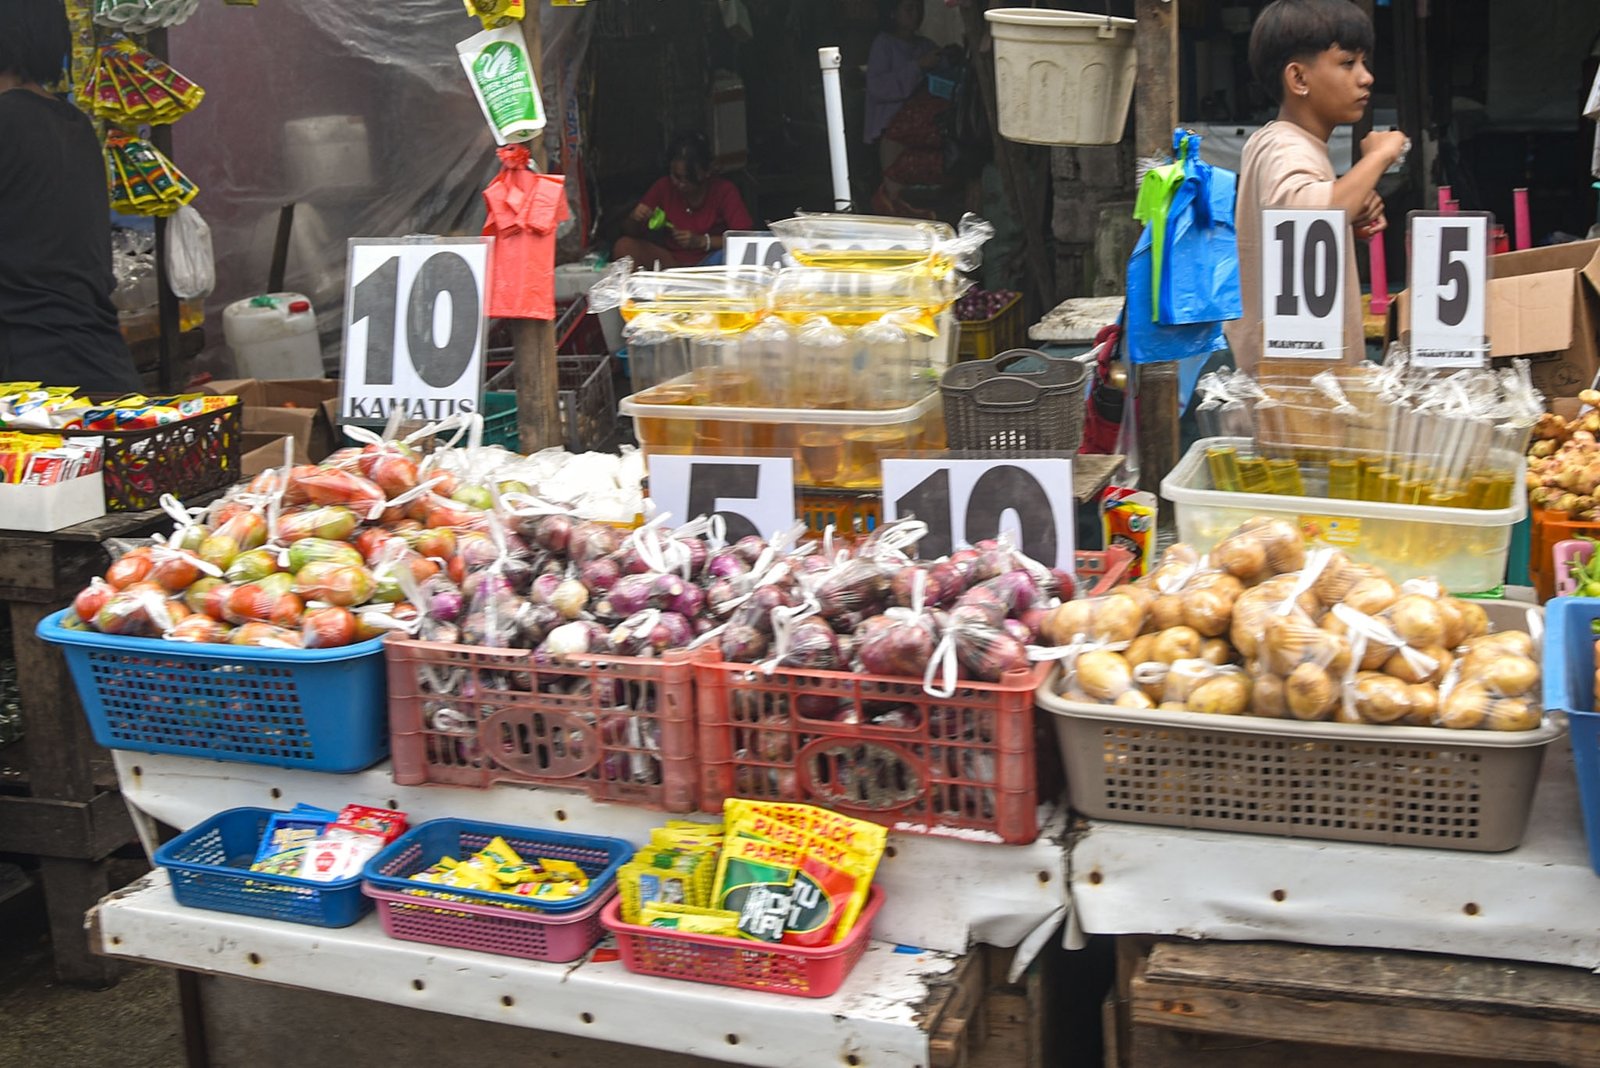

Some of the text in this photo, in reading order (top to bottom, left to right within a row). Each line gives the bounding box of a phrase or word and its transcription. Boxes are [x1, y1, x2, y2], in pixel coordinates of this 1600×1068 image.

[1275, 219, 1338, 318] 10
[1437, 227, 1470, 326] 5
[350, 251, 479, 388] 10
